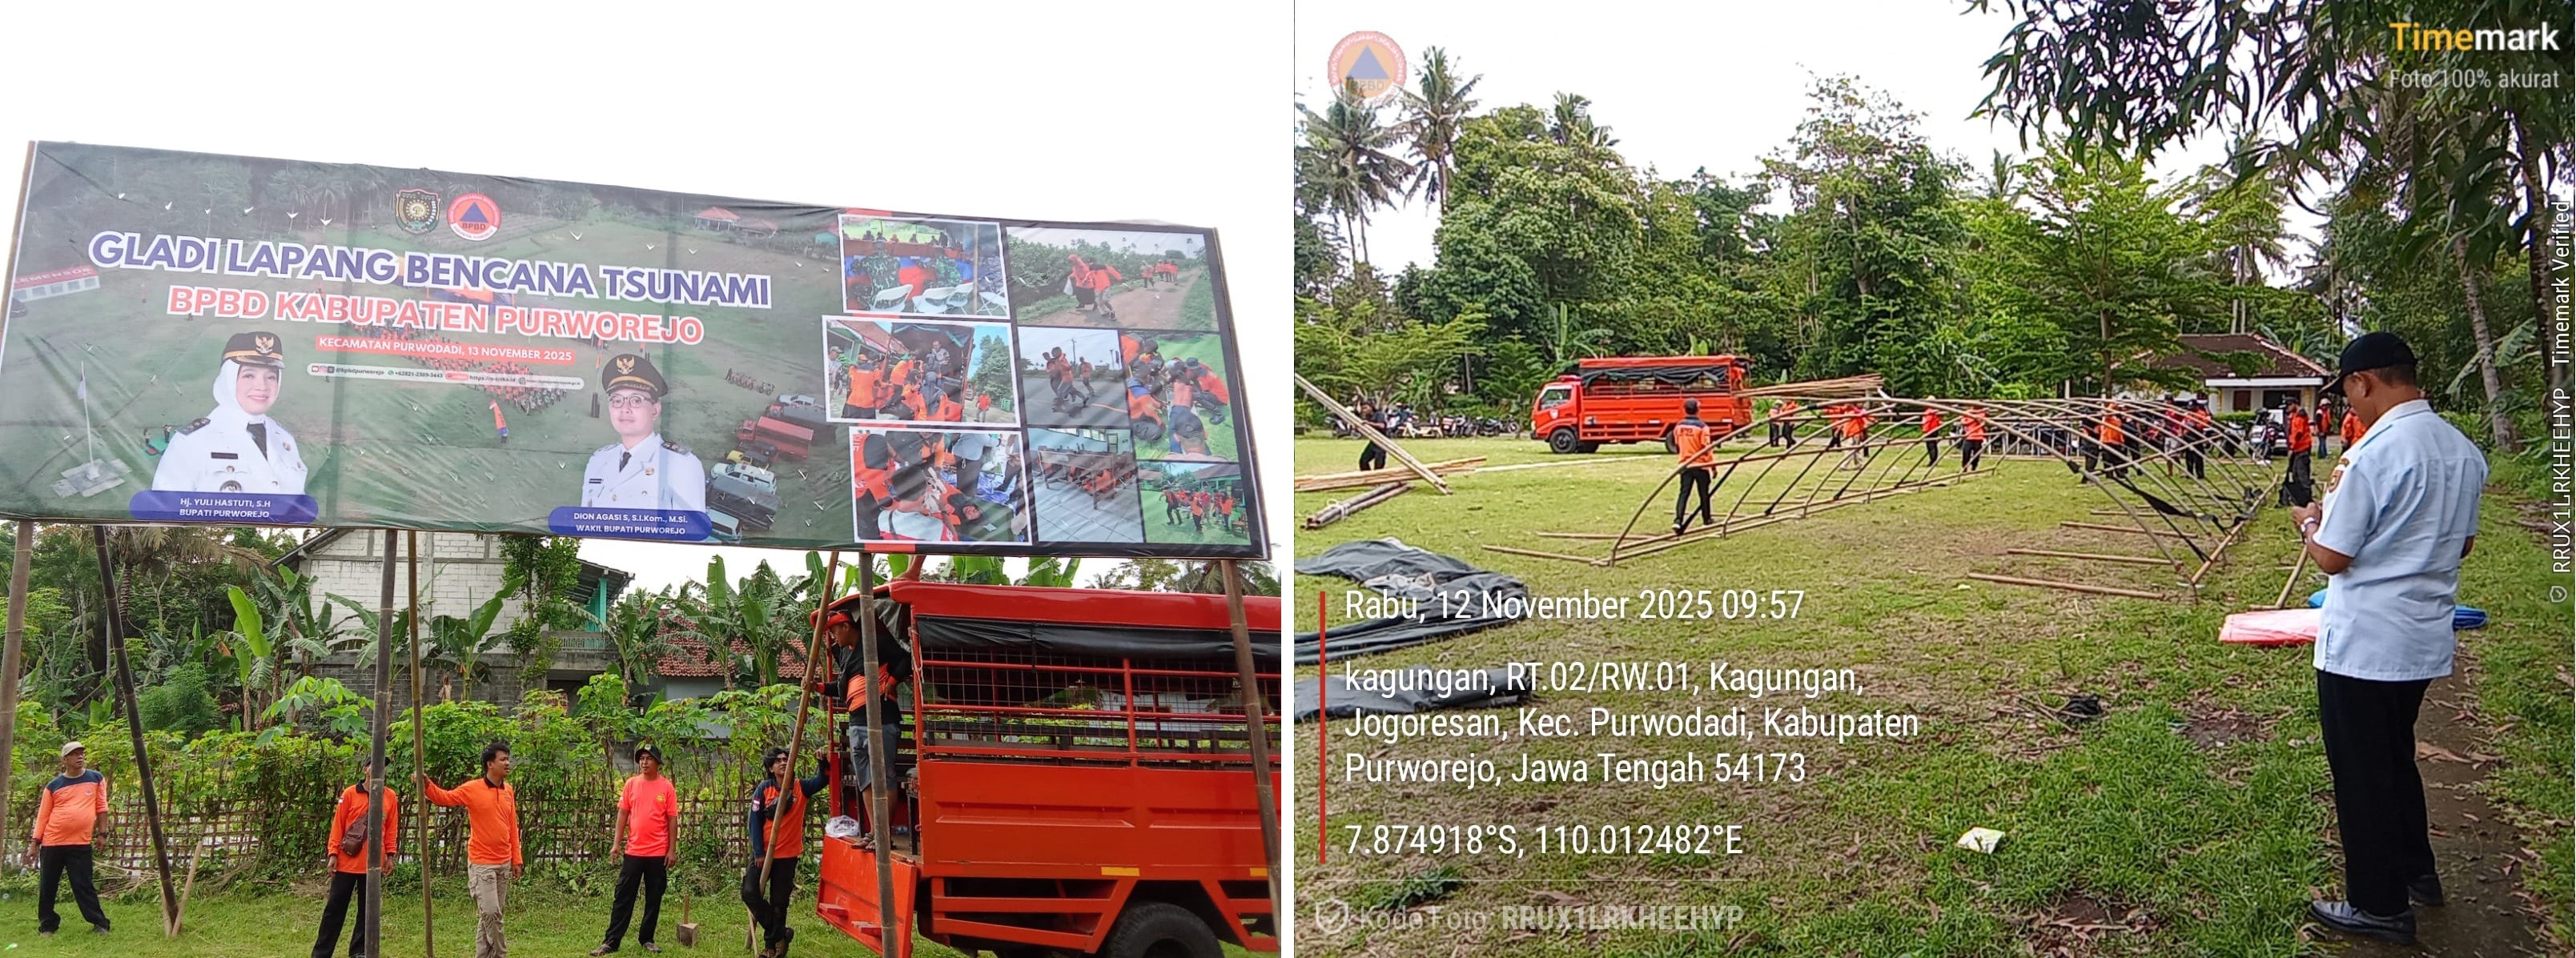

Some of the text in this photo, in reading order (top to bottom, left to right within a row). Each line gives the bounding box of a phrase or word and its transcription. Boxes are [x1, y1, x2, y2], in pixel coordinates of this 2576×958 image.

[14, 267, 91, 284] EMENSOS
[90, 233, 770, 307] GLADI LAPANG BENCANA TSUNAMI
[170, 287, 702, 344] BPBD KABUPATEN PURWOREJO
[319, 337, 572, 361] KECAMATAN PURWODADI, 13 NOVEMBER 2025
[215, 499, 255, 508] HASTUTI,
[255, 500, 271, 508] S.H
[179, 509, 270, 519] BUPATI PURWOREJO
[573, 512, 689, 523] DION AGASI S, S.I.Kom., M.Si.
[576, 524, 685, 535] WAKIL BUPATI PURWOREJO
